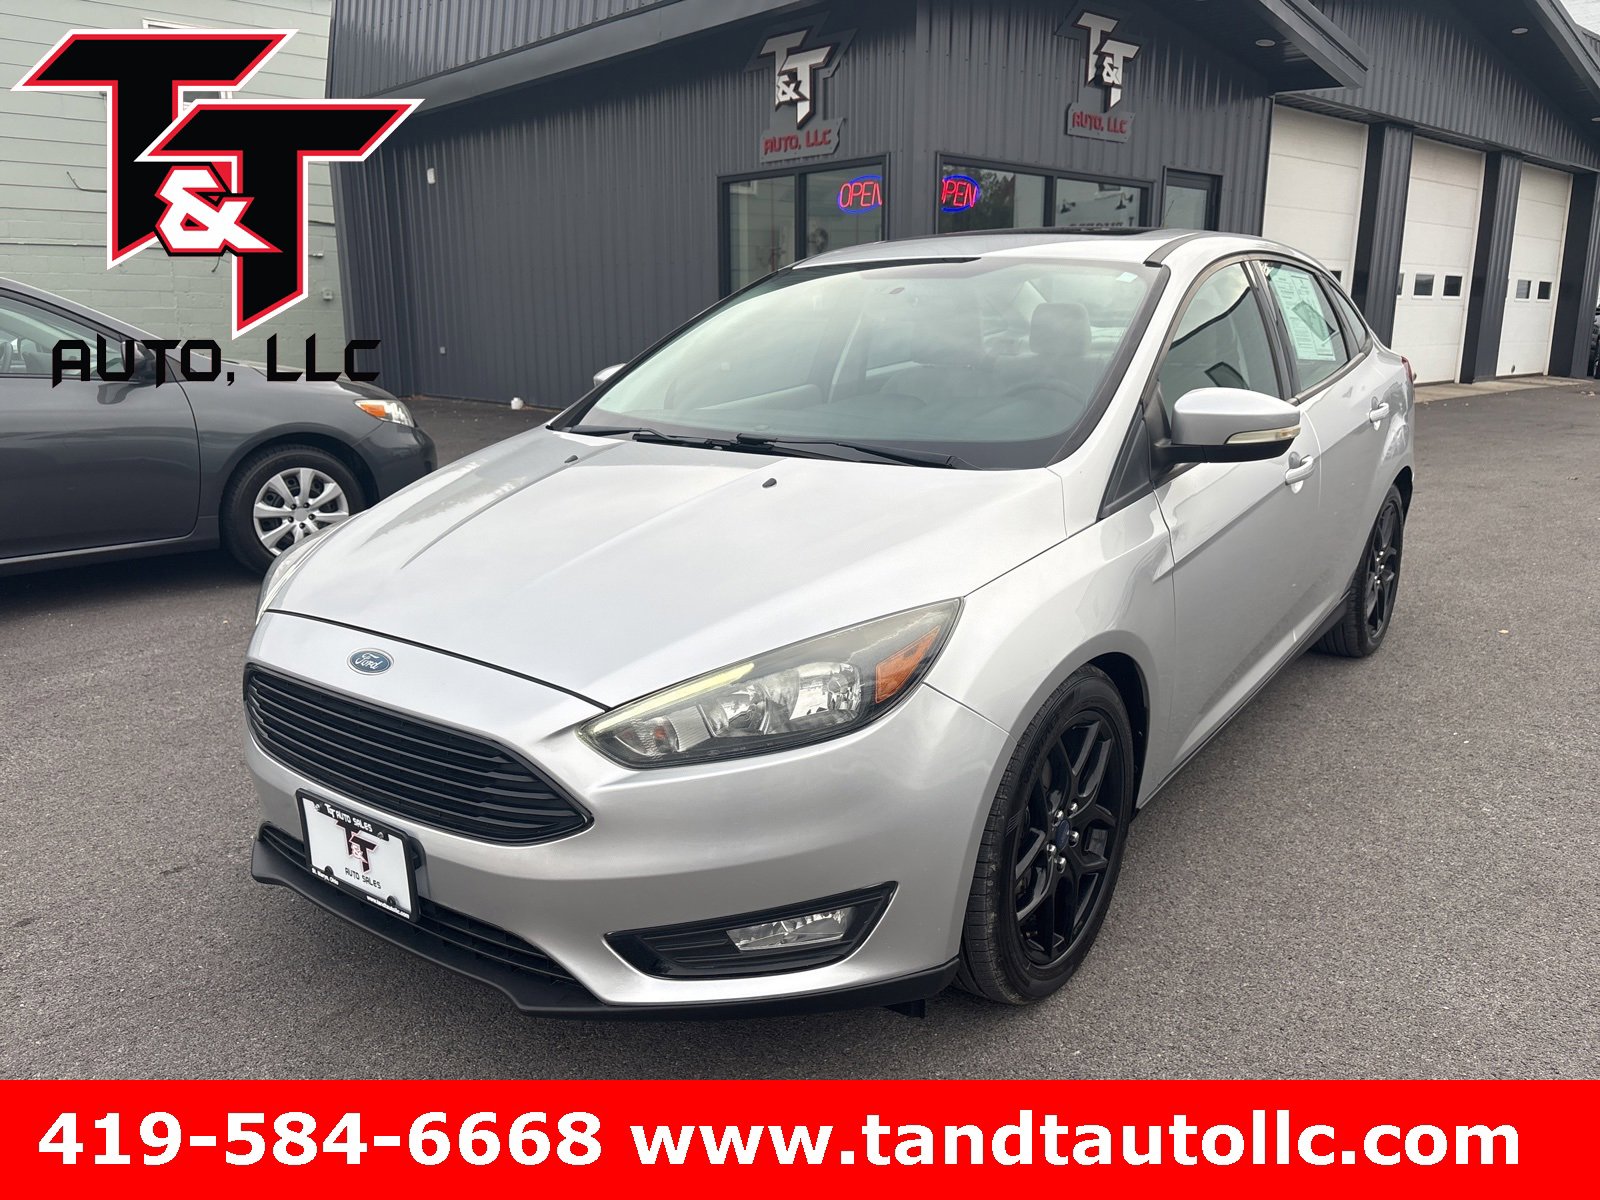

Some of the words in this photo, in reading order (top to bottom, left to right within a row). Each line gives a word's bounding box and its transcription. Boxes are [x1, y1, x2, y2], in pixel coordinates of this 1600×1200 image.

[1075, 10, 1141, 109] T&T
[758, 28, 833, 127] T&T
[1071, 111, 1105, 132] AUTO,
[1107, 115, 1129, 134] LLC
[763, 134, 801, 155] AUTO,
[805, 128, 832, 148] LLC
[941, 179, 978, 208] PEN
[355, 652, 384, 670] Ford
[336, 810, 352, 824] AUTO
[352, 817, 373, 832] SALES
[344, 867, 360, 881] AUTO
[361, 874, 382, 889] SALES
